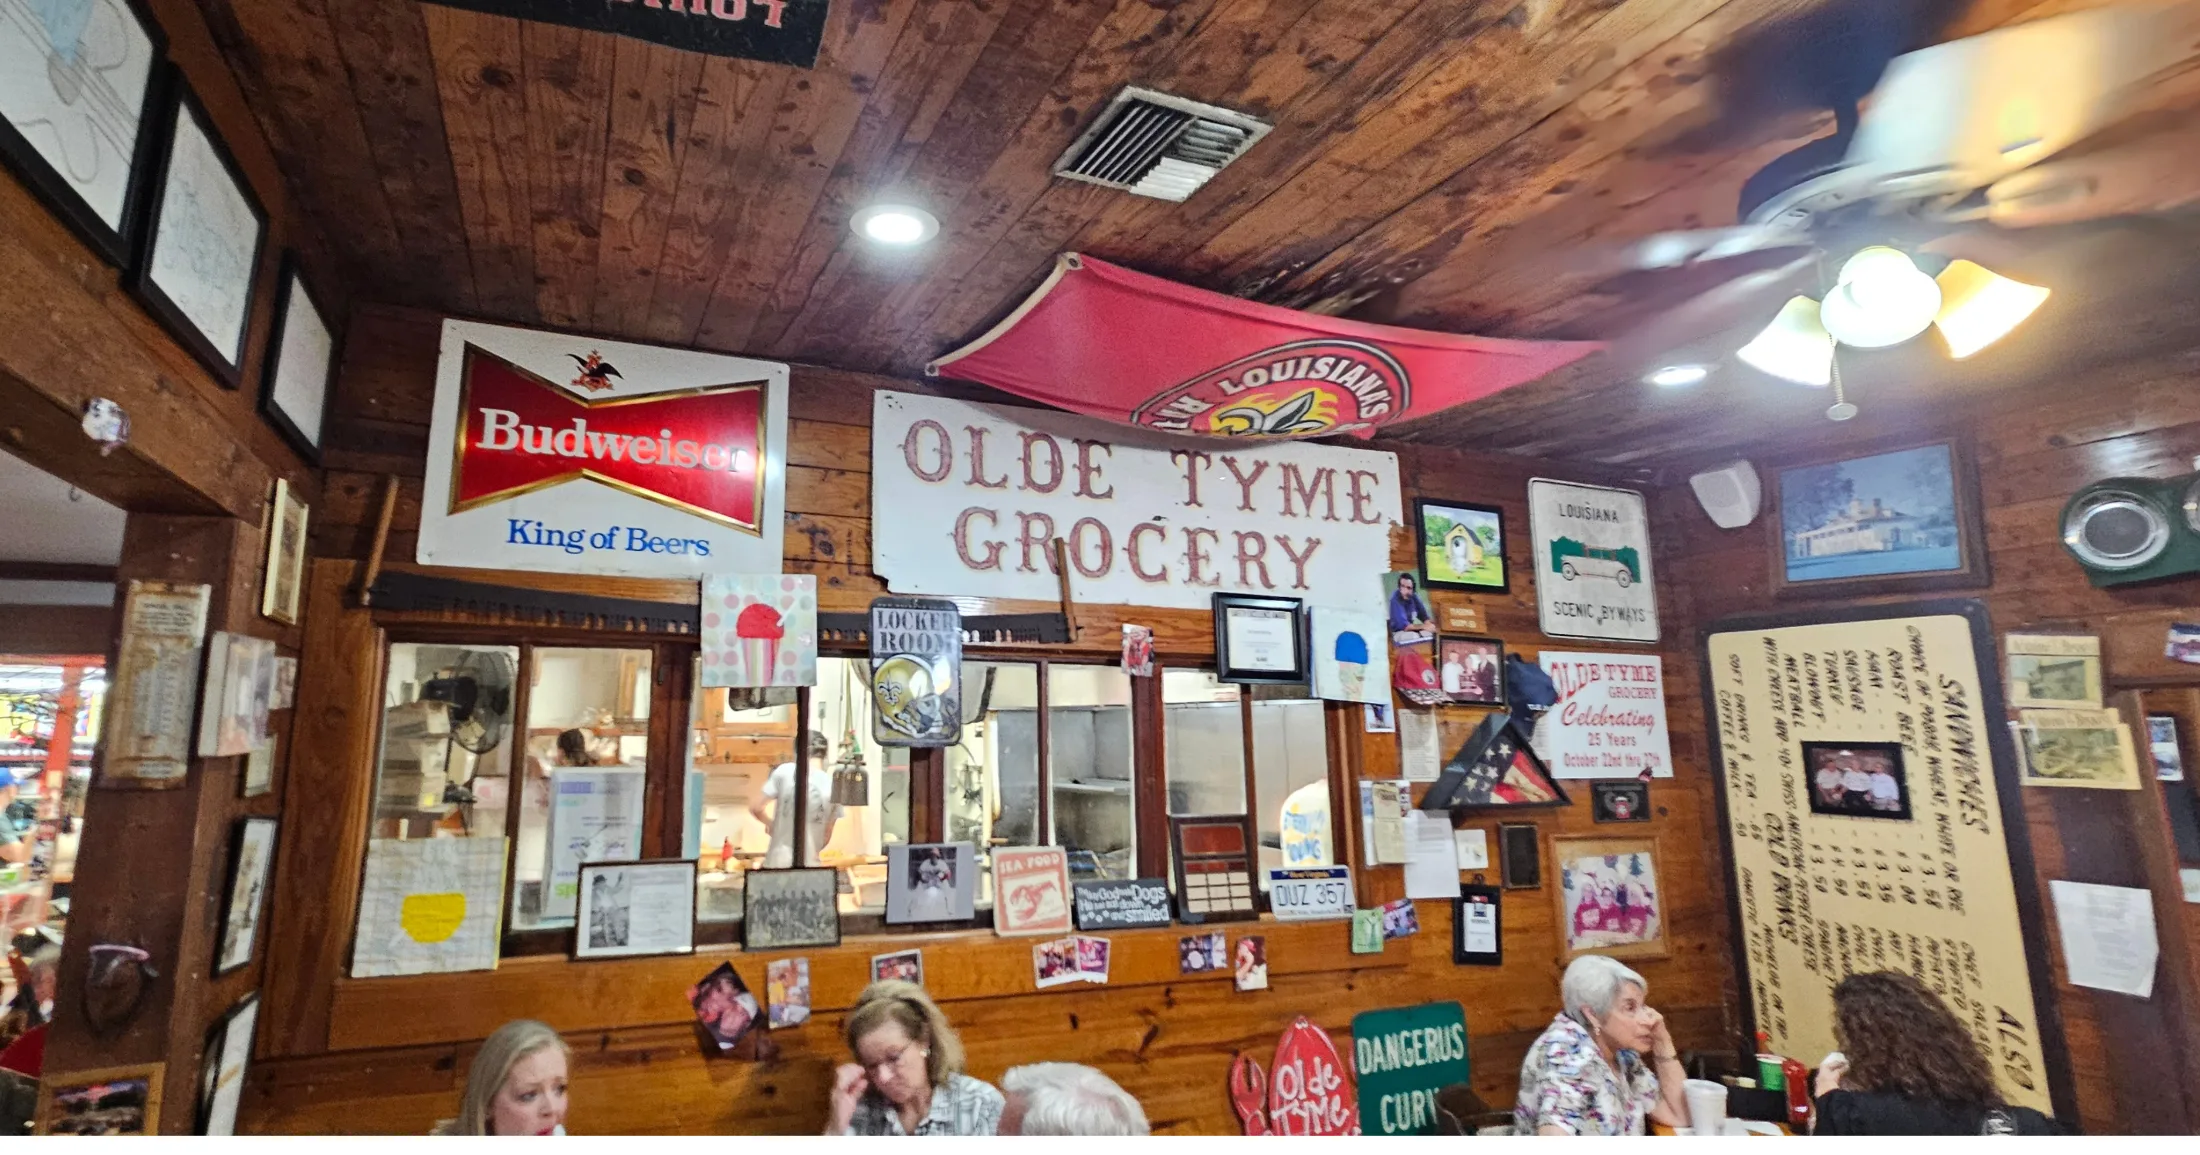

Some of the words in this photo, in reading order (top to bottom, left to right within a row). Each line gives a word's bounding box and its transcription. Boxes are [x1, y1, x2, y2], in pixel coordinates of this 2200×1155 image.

[1217, 355, 1393, 419] LOUISIANA'S
[475, 407, 750, 473] Budweiser
[897, 418, 1114, 499] OLDE
[1170, 449, 1383, 525] TYME
[1558, 502, 1620, 524] LOUISIANA
[506, 518, 585, 554] King
[590, 526, 620, 550] of
[625, 527, 710, 557] Beers
[947, 507, 1322, 592] GROCERY
[877, 610, 955, 632] LOCKER
[1553, 601, 1594, 620] SCENIC
[1729, 653, 1744, 687] SOFT
[1762, 636, 1781, 665] WITH
[1864, 649, 1884, 689] HAM
[1906, 625, 1929, 676] CHOICE
[1552, 662, 1601, 704] OLDE
[1605, 664, 1656, 682] TYME
[1608, 686, 1657, 699] GROCERY
[1766, 668, 1786, 713] CHEESE
[1783, 653, 1805, 728] MEATBALL
[1803, 652, 1825, 723] BLOWOUT
[1823, 649, 1843, 706] TURKEY
[1843, 649, 1866, 714] SAUSAGE
[1886, 647, 1911, 705] ROAST
[1915, 680, 1933, 700] OF
[1561, 702, 1655, 736] Celebrating
[1719, 689, 1737, 737] COFFEE
[1733, 693, 1751, 743] DRINKS
[1896, 711, 1919, 757] BEEF
[1563, 752, 1599, 767] October
[1588, 732, 1601, 746] 25
[1606, 732, 1637, 747] Years
[1937, 673, 1990, 835] SANDWICHES
[1727, 757, 1742, 790] MILK
[1744, 773, 1757, 799] TEA
[1764, 812, 1791, 868] COLD
[1934, 812, 1957, 859] WHITE
[1000, 860, 1024, 874] SEA
[1026, 853, 1060, 869] FOOD
[1942, 862, 1960, 882] OR
[1125, 904, 1169, 923] smiled
[1130, 884, 1166, 904] Dogs
[1275, 884, 1310, 906] DUZ
[1315, 883, 1346, 904] 357
[1740, 866, 1758, 925] DOMESTIC
[1770, 870, 1799, 945] DRINKS
[1947, 886, 1966, 916] RYE
[1762, 923, 1781, 989] MICHELOB
[1800, 924, 1820, 976] CHEESE
[1851, 924, 1869, 967] CHILI
[1886, 930, 1905, 962] HOT
[1961, 941, 1983, 990] CHEF
[1943, 938, 1968, 1011] STUFFED
[1771, 993, 1784, 1013] ON
[1356, 1022, 1464, 1075] DANGERUS
[1993, 1005, 2034, 1091] ALSO
[1276, 1056, 1341, 1100] Olde
